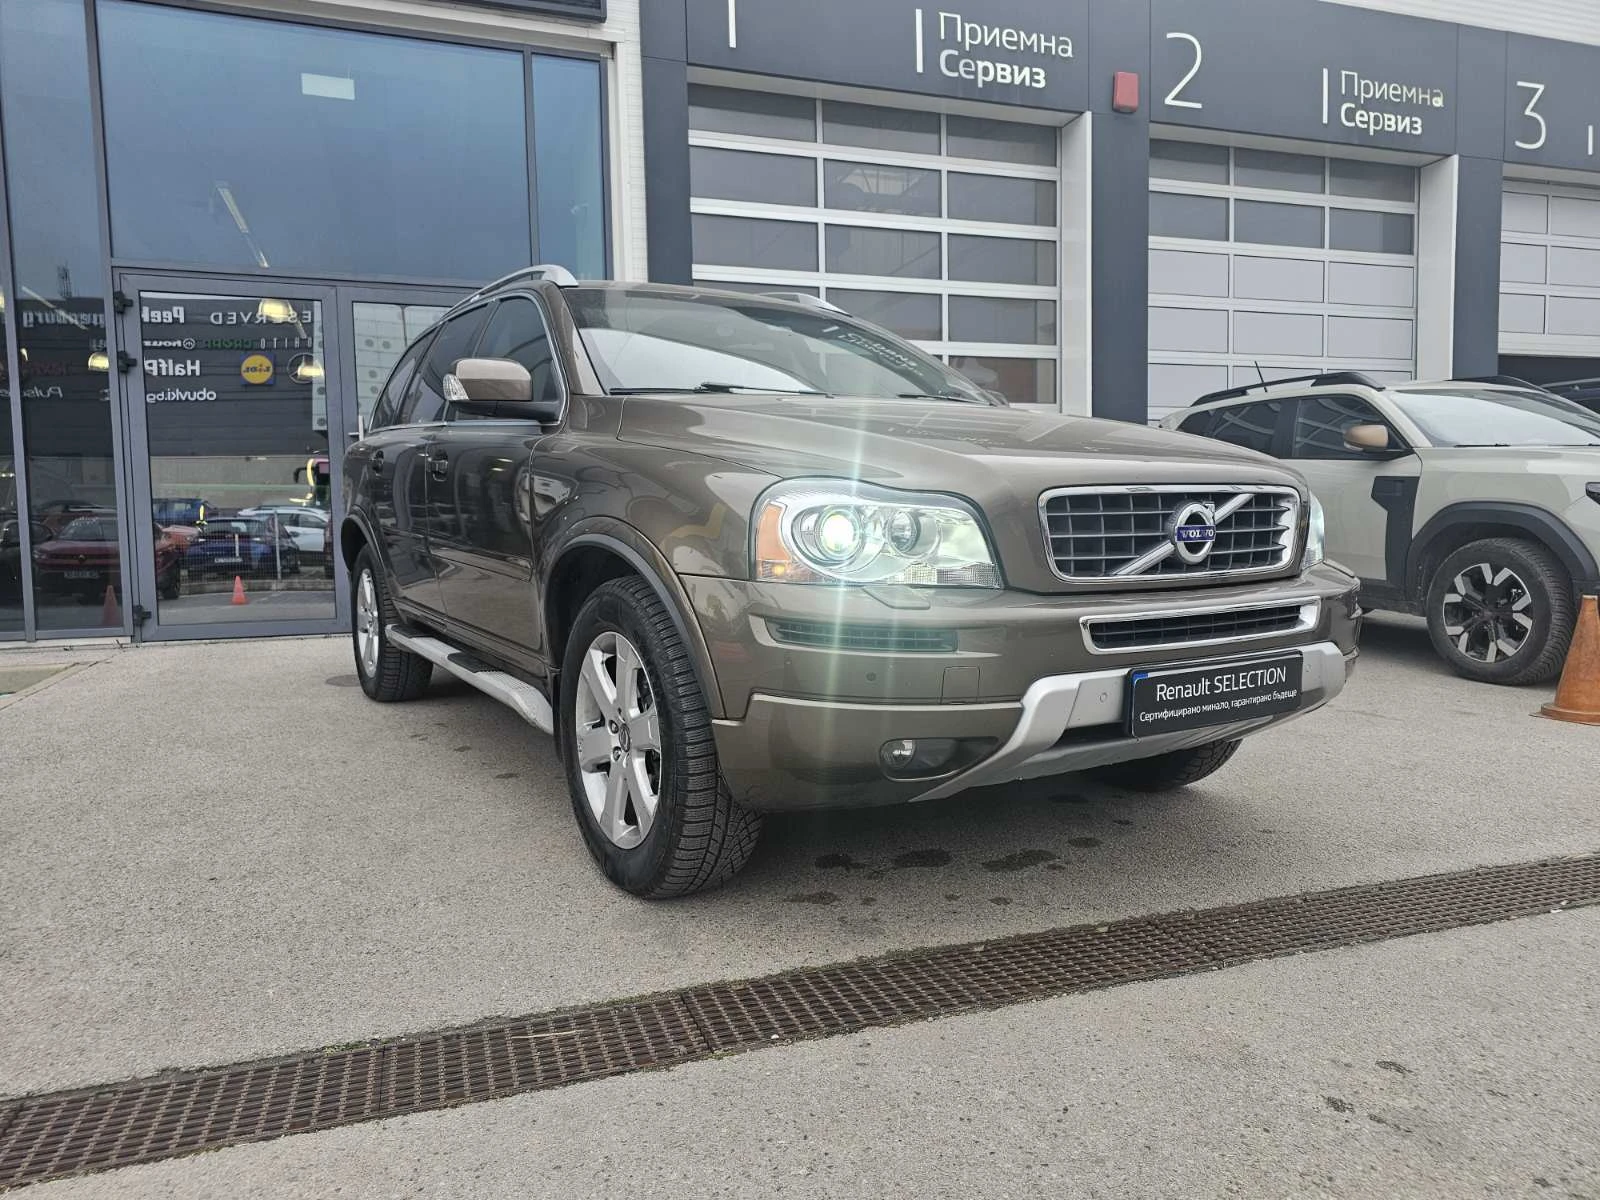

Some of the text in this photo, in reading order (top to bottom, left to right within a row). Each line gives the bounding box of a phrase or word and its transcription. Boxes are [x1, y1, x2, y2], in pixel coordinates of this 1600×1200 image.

[938, 11, 1074, 58] Приемна
[939, 49, 1047, 88] Сервиз
[1163, 32, 1203, 108] 2
[1340, 70, 1444, 108] Приемна
[1340, 103, 1423, 135] Сервиз
[1514, 80, 1547, 150] 3
[1179, 529, 1214, 539] VOLVO
[1156, 666, 1287, 701] Renault SELECTION
[1139, 688, 1298, 723] Сертифицирано минало, гарантирано бъдеще
